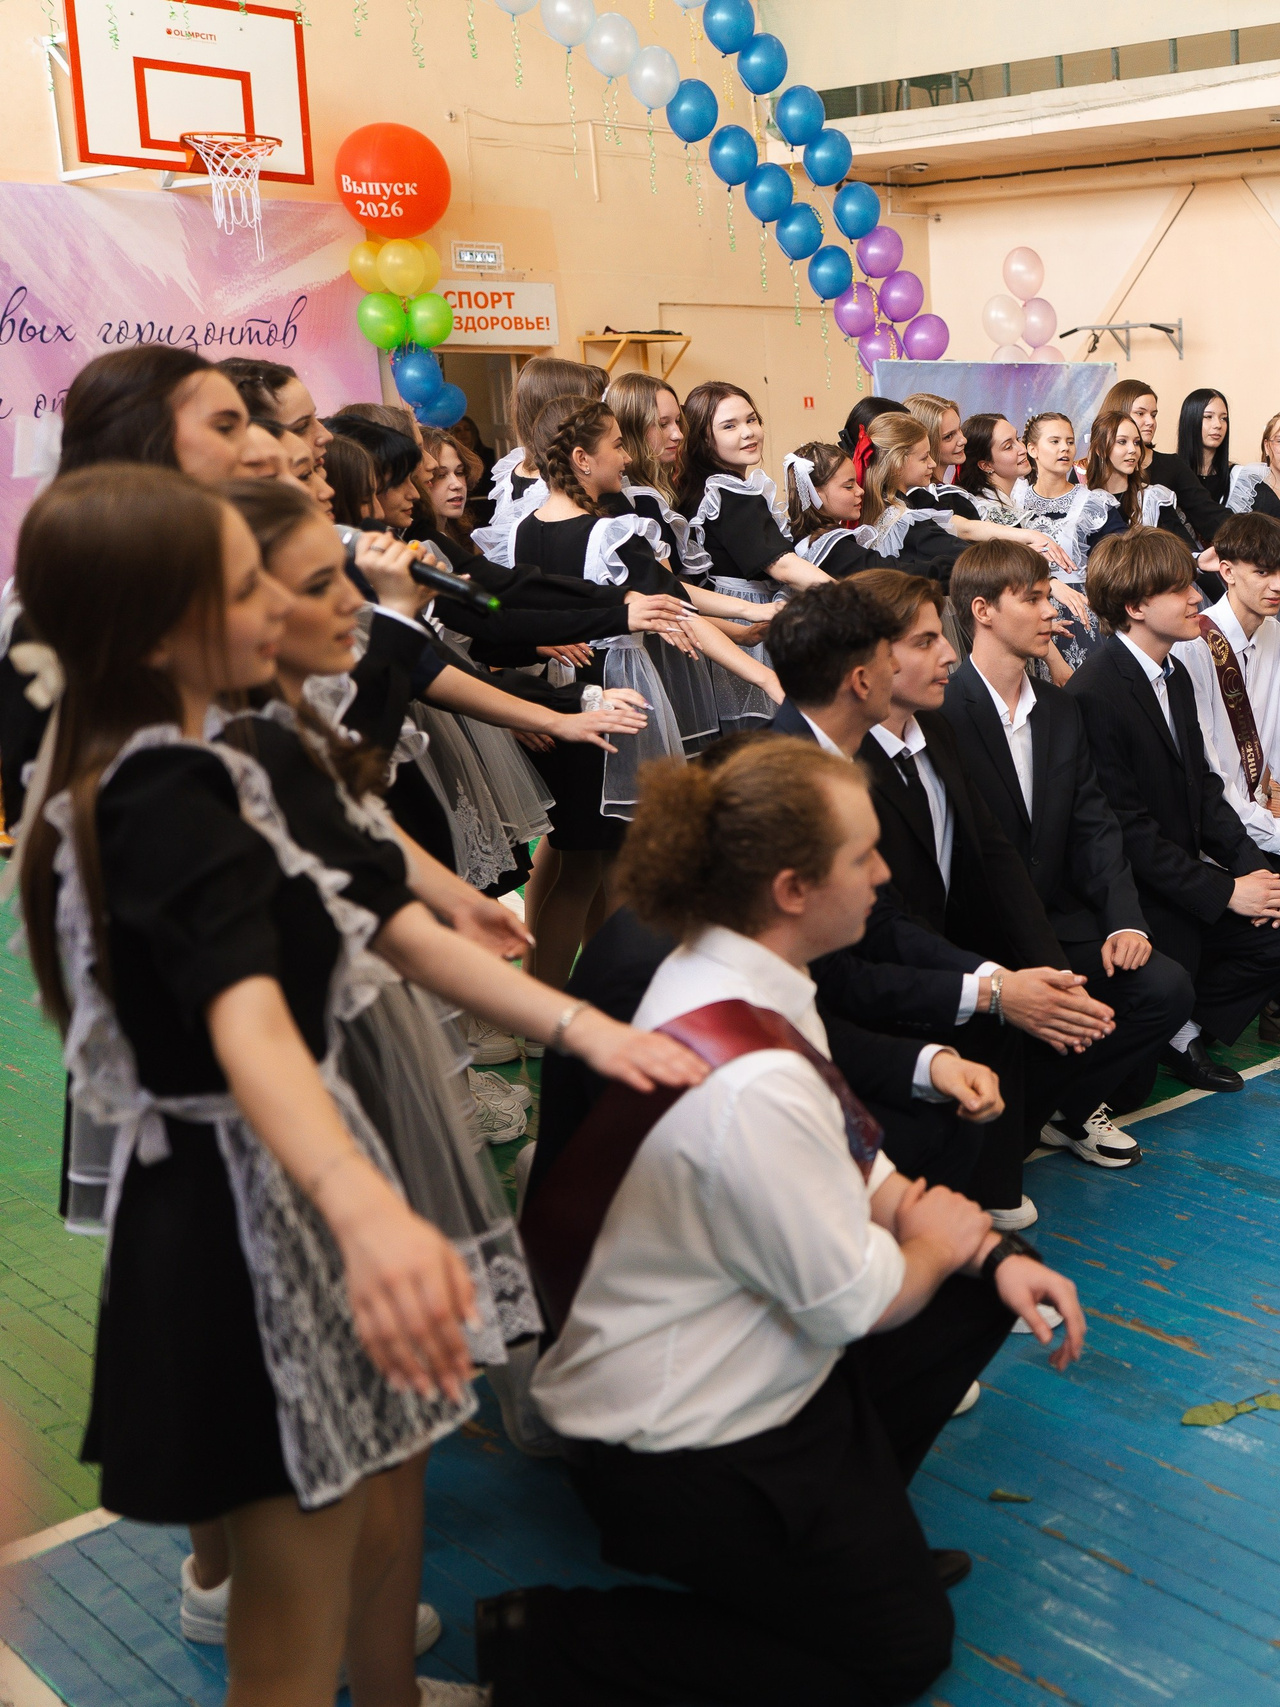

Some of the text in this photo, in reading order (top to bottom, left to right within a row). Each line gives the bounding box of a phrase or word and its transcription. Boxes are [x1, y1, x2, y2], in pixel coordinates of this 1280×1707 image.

[341, 174, 418, 200] Выпуск
[355, 200, 404, 218] 2026
[443, 290, 515, 309] СПОРТ
[97, 295, 307, 352] горизонтов
[453, 316, 550, 333] ЗДОРОВЬЕ!
